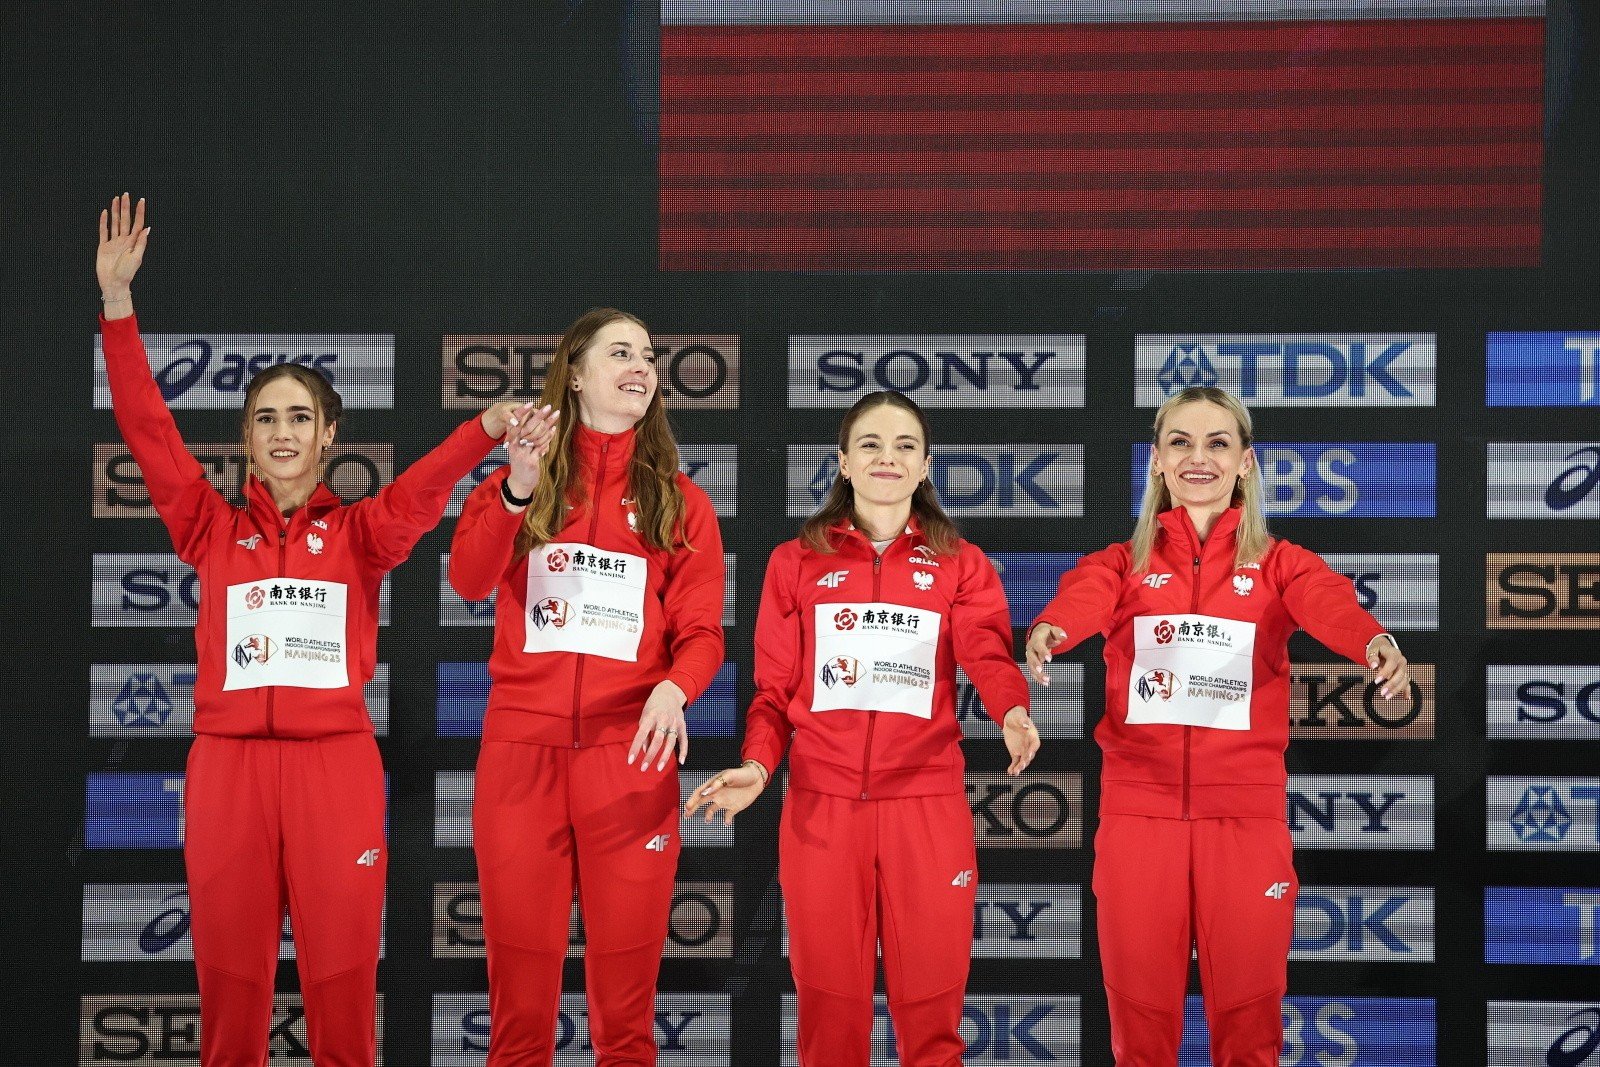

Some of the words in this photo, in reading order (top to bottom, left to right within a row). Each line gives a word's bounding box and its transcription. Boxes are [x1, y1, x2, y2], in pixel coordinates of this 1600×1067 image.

[455, 345, 727, 398] SEO
[817, 350, 1056, 392] SONY
[1217, 342, 1413, 398] TDK
[932, 452, 1060, 508] DK
[1262, 448, 1360, 514] BS
[573, 550, 627, 573] 南京银行
[908, 556, 940, 568] ORLEN
[816, 570, 850, 589] 4F
[1141, 573, 1173, 589] 4F
[270, 585, 327, 602] 南京银行
[583, 603, 607, 613] WORLD
[607, 607, 639, 619] ATHLETICS
[862, 609, 920, 629] 南京银行
[285, 636, 309, 644] WORLD
[309, 639, 341, 649] ATHLETICS
[285, 649, 329, 662] NANJING
[873, 660, 898, 669] WORLD
[898, 663, 931, 676] ATHLETICS
[872, 673, 918, 687] NANJING
[1189, 674, 1214, 683] WORLD
[1213, 677, 1248, 688] ATHLETICS
[1187, 687, 1233, 700] NANJING
[645, 833, 671, 852] 4F
[356, 848, 381, 867] 4F
[951, 869, 973, 888] 4F
[1264, 882, 1290, 900] 4F
[1292, 896, 1412, 954] DK
[1280, 1001, 1359, 1067] BS
